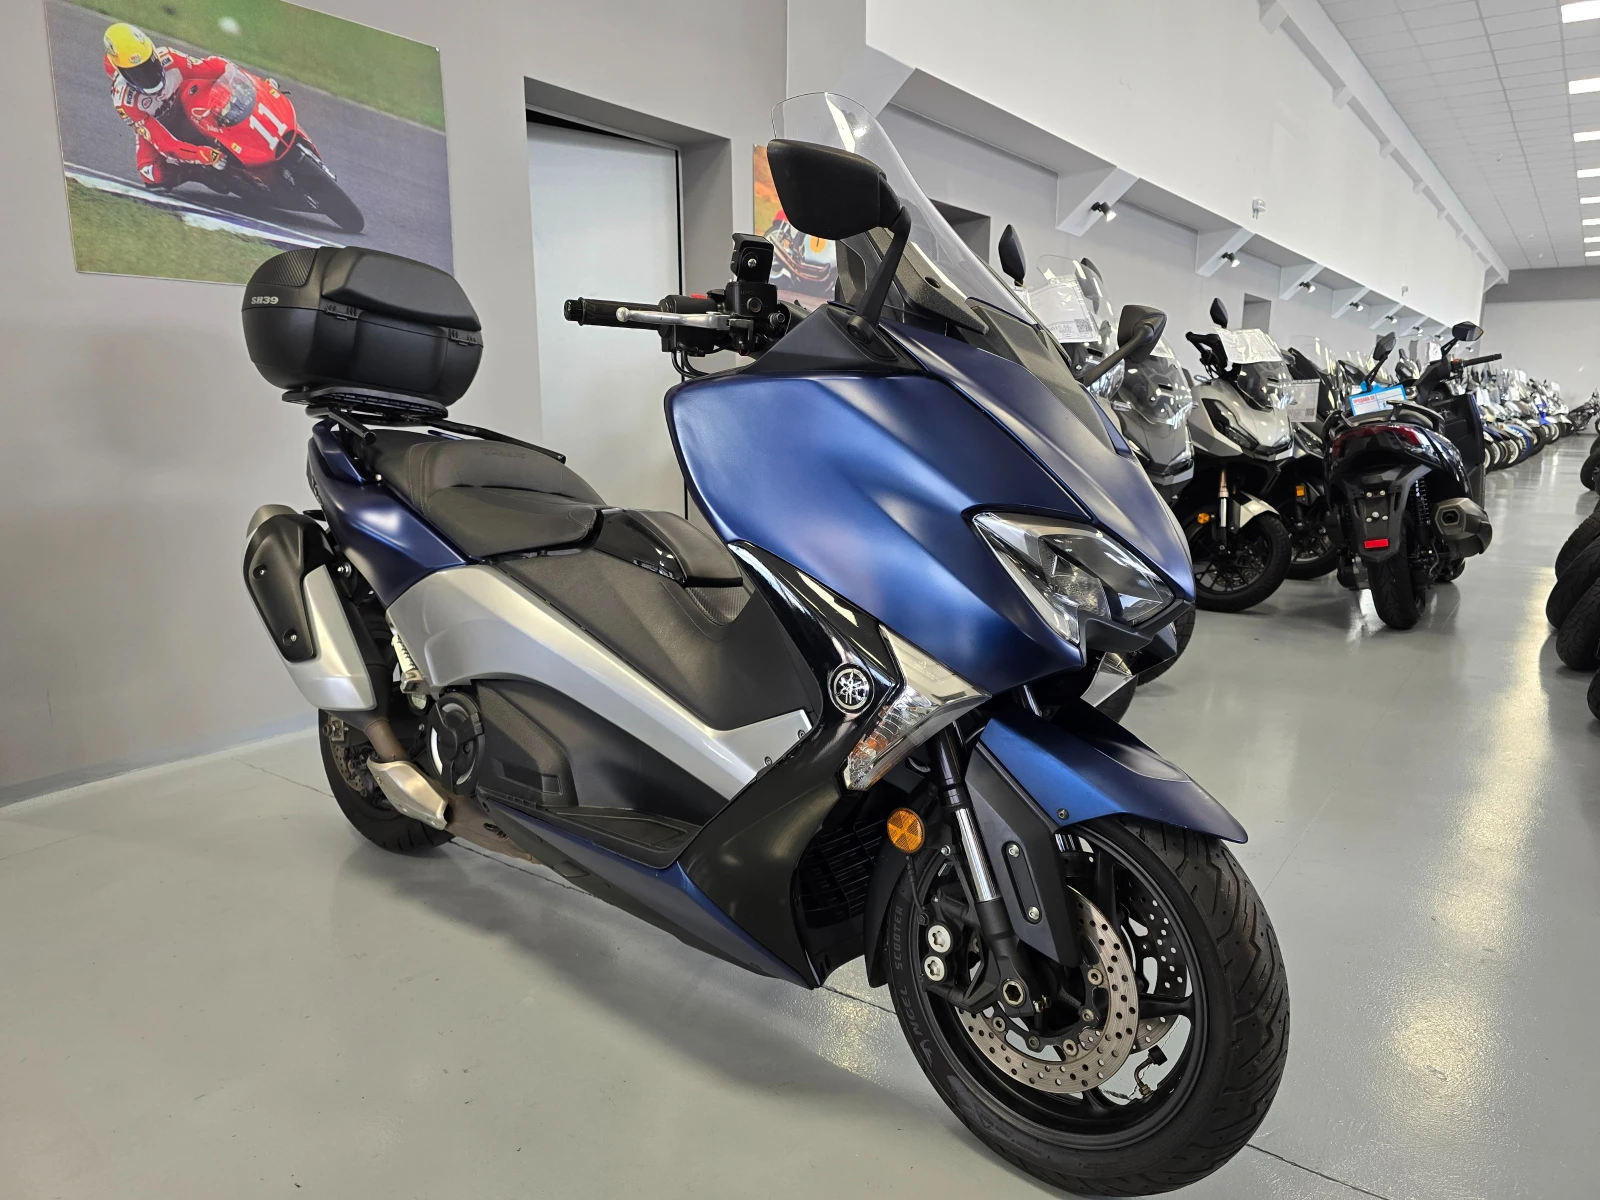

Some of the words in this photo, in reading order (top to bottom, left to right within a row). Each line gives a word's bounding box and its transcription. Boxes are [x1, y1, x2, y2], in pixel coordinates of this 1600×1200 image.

[249, 102, 288, 151] 11
[251, 296, 279, 305] SH39
[893, 905, 903, 971] SCOOTER
